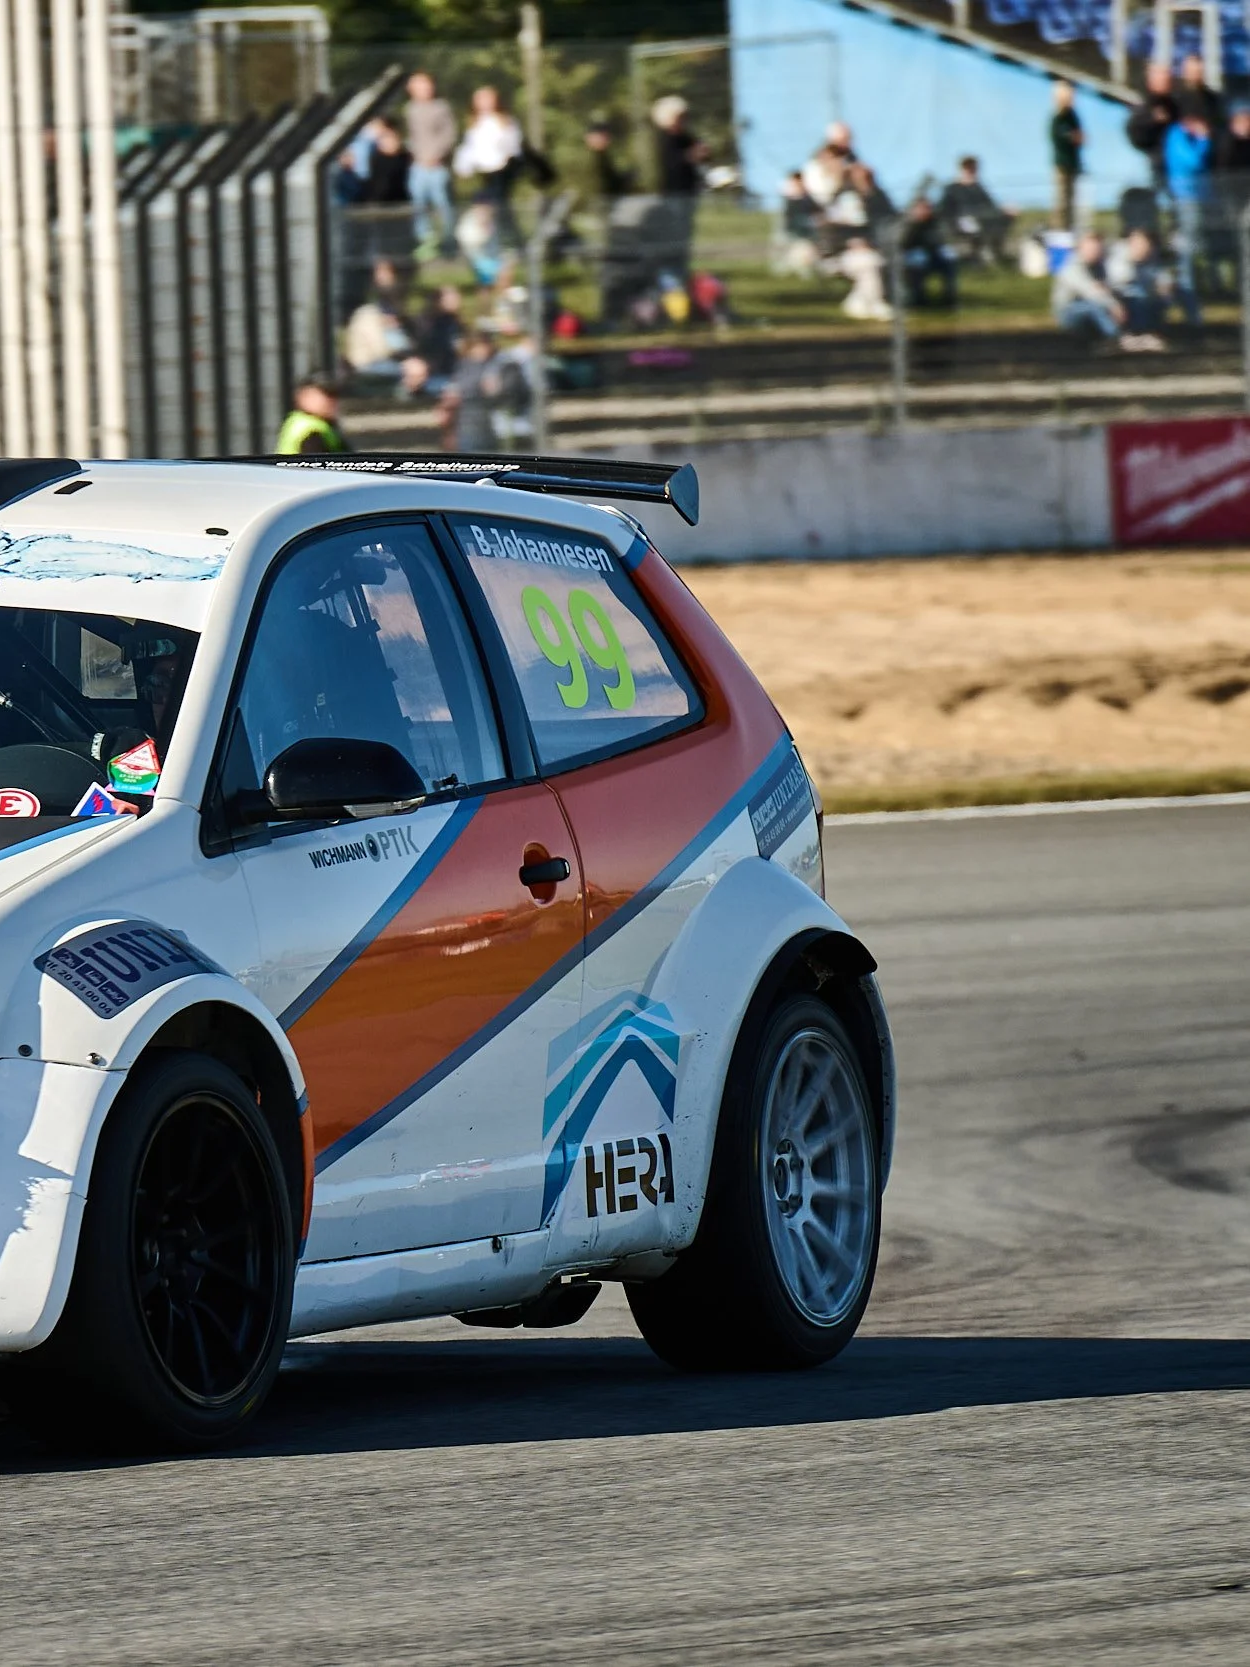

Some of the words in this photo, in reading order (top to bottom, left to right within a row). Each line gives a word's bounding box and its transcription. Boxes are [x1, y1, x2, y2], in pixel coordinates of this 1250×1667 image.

[521, 585, 636, 711] 99
[308, 842, 367, 868] WICHMANN
[365, 825, 420, 862] OPTIK
[584, 1133, 675, 1218] HERA
